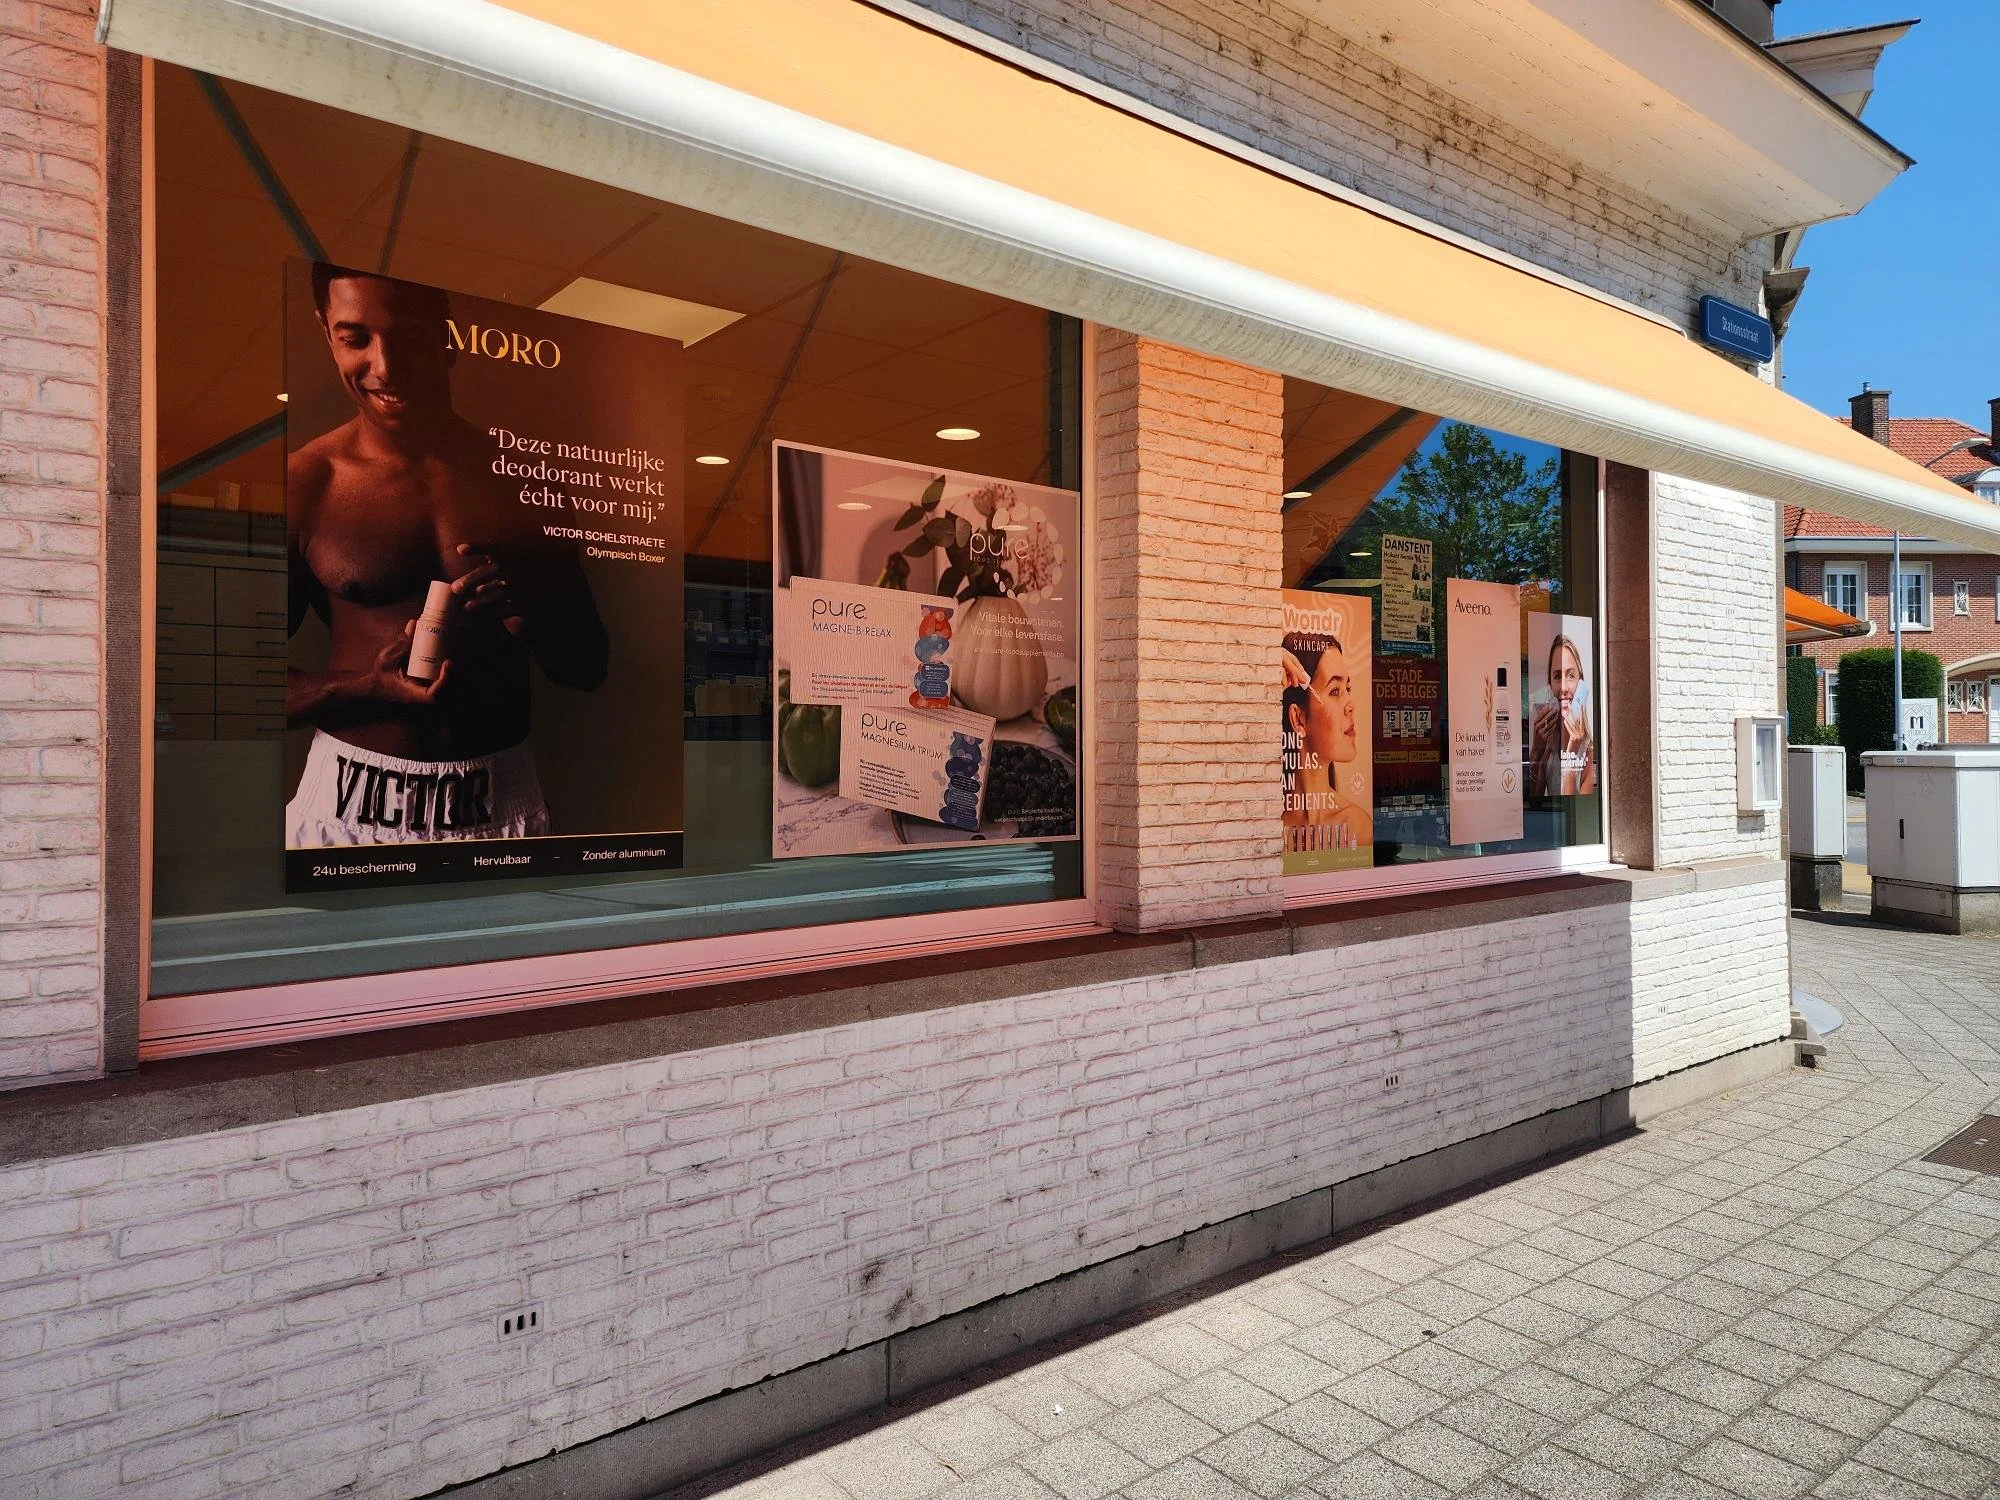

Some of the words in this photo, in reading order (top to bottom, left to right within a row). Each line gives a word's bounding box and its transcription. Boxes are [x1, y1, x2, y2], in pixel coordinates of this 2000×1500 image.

[445, 319, 561, 369] MORO
[488, 427, 551, 455] “Deze
[557, 443, 665, 474] natuurlijke
[491, 455, 603, 488] deodorant
[608, 475, 665, 497] werkt
[519, 484, 565, 508] écht
[570, 496, 617, 515] voor
[623, 500, 665, 524] mij.”
[543, 526, 583, 540] VICTOR
[585, 530, 666, 549] SCHELSTRAETE
[586, 546, 637, 560] Olympisch
[639, 551, 666, 563] Boxer
[1384, 538, 1431, 555] DANSTENT
[978, 611, 1007, 624] Vitale
[1282, 605, 1342, 634] Wondr
[970, 625, 993, 637] Voor
[994, 627, 1014, 638] elke
[1015, 628, 1065, 642] levensfase.
[1293, 639, 1330, 652] SKINCARE
[1388, 668, 1423, 683] STADE
[1376, 683, 1398, 698] DES
[1400, 684, 1438, 699] BELGES
[1386, 711, 1396, 721] 15
[1403, 711, 1412, 721] 21
[1419, 711, 1428, 721] 27
[861, 731, 916, 753] MAGNESIUM
[917, 745, 943, 760] TRIUM
[1455, 732, 1465, 743] De
[1466, 732, 1485, 743] kracht
[1455, 749, 1467, 757] van
[1468, 746, 1485, 756] haver
[337, 754, 491, 831] VICTOR
[312, 866, 337, 877] 24u
[339, 861, 417, 876] bescherming
[473, 854, 532, 867] Hervulbaar
[582, 849, 617, 861] Zonder
[618, 847, 666, 859] aluminium
